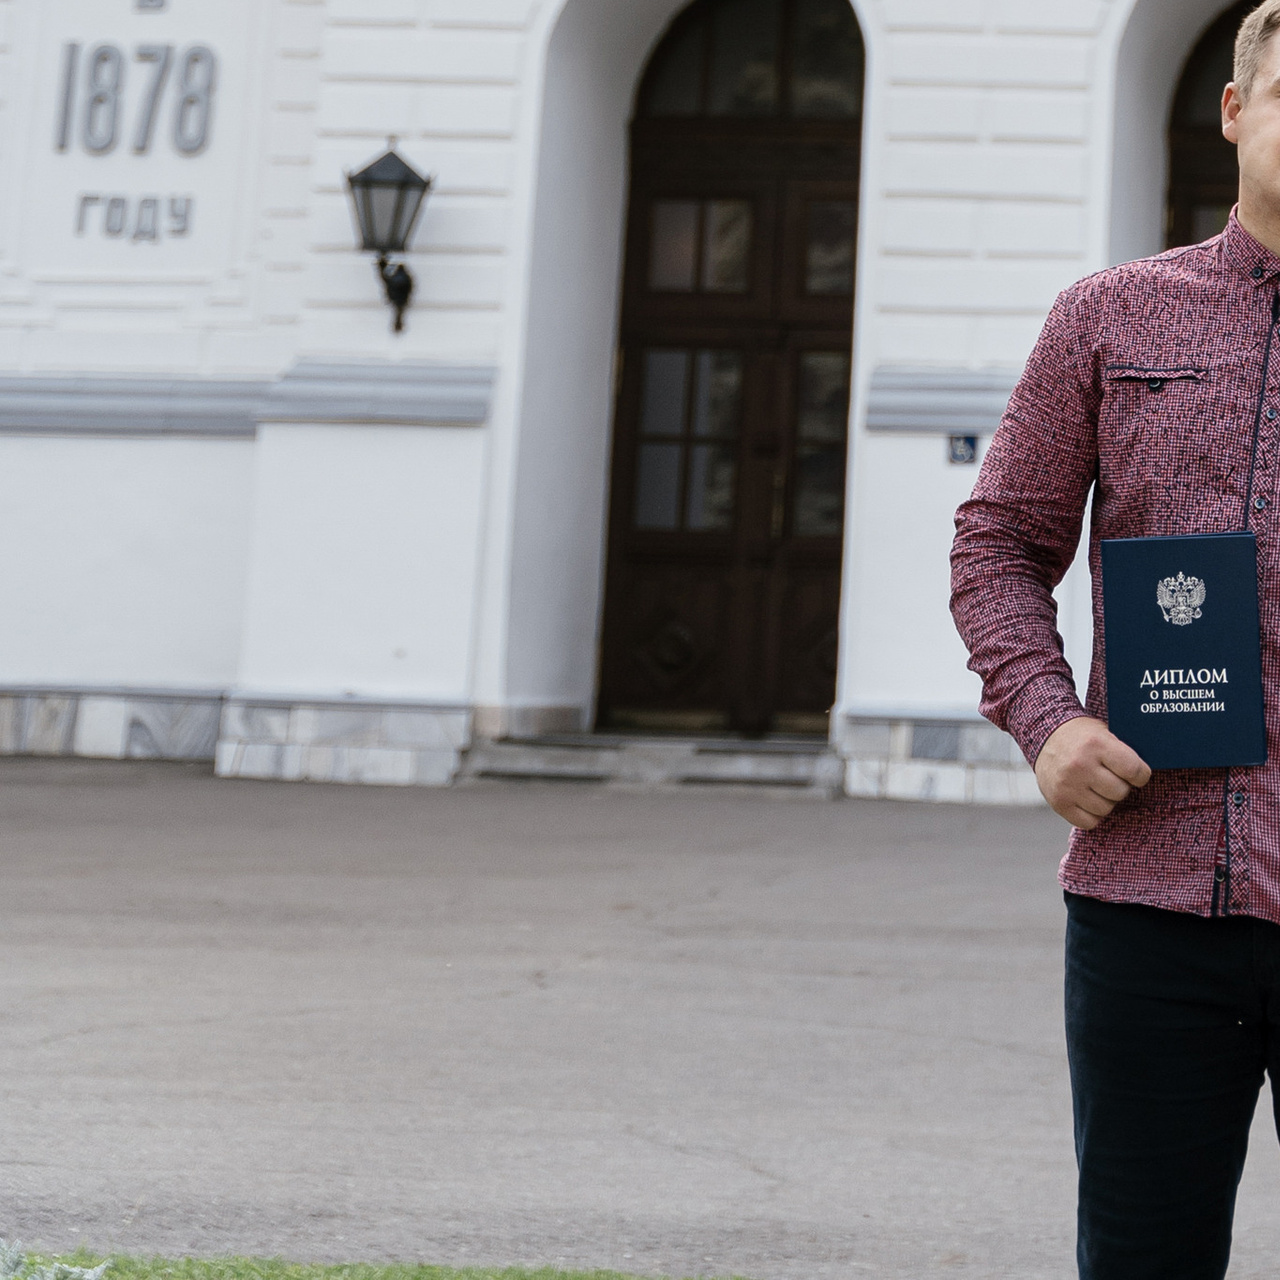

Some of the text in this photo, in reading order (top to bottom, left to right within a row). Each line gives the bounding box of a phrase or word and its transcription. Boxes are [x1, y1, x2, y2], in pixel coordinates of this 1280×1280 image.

[55, 42, 217, 157] 1878
[1139, 668, 1228, 688] ДИПЛОМ
[1149, 688, 1215, 701] О ВЫСШЕМ
[1140, 702, 1225, 714] ОБРАЗОВАНИИ
